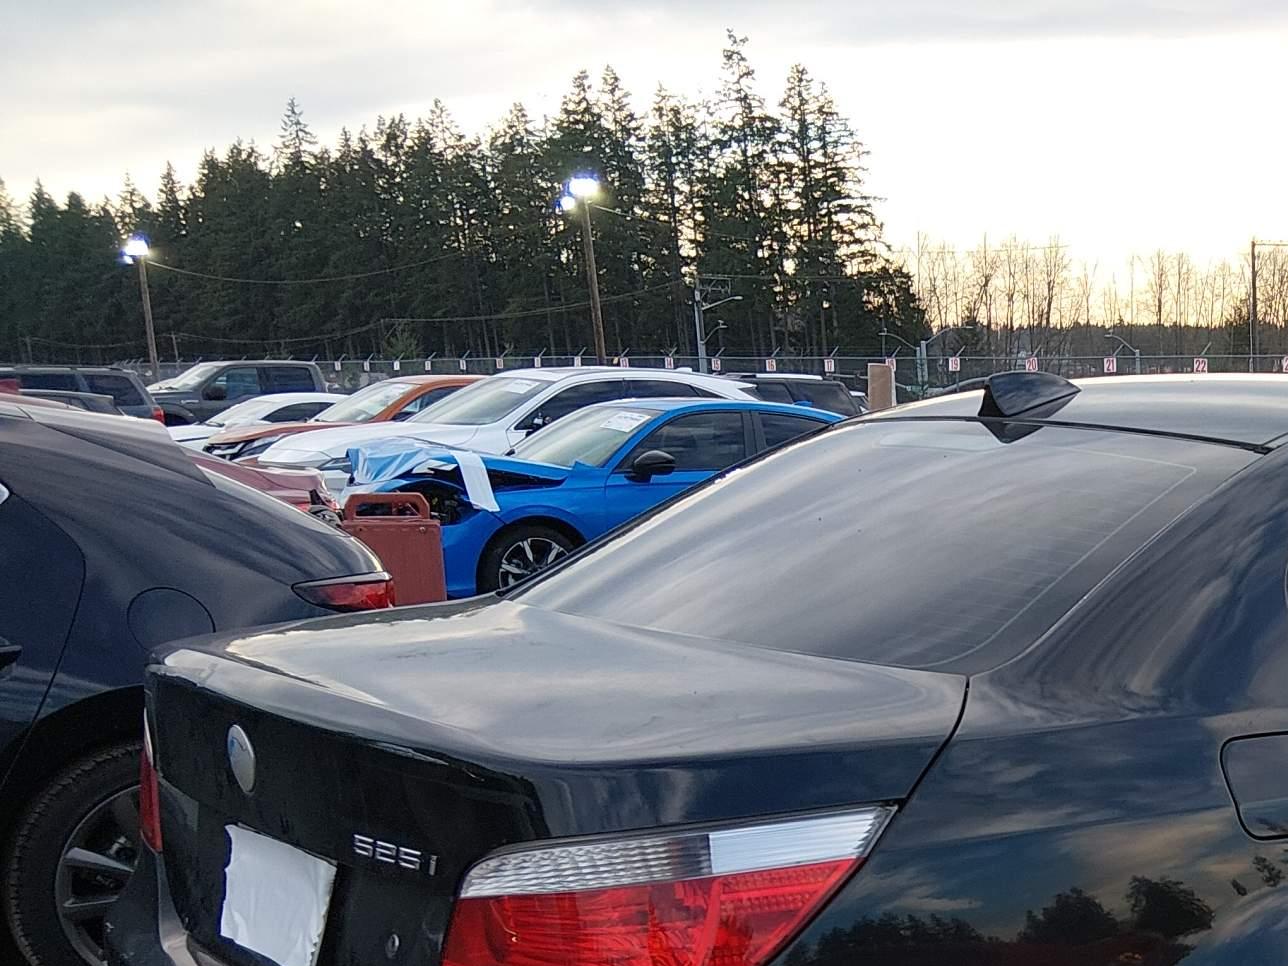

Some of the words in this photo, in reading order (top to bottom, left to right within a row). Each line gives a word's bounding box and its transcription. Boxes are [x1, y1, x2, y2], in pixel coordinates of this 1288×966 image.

[1026, 358, 1037, 371] 20
[1106, 359, 1115, 371] 21
[1195, 359, 1207, 373] 22
[353, 834, 439, 877] 525i
